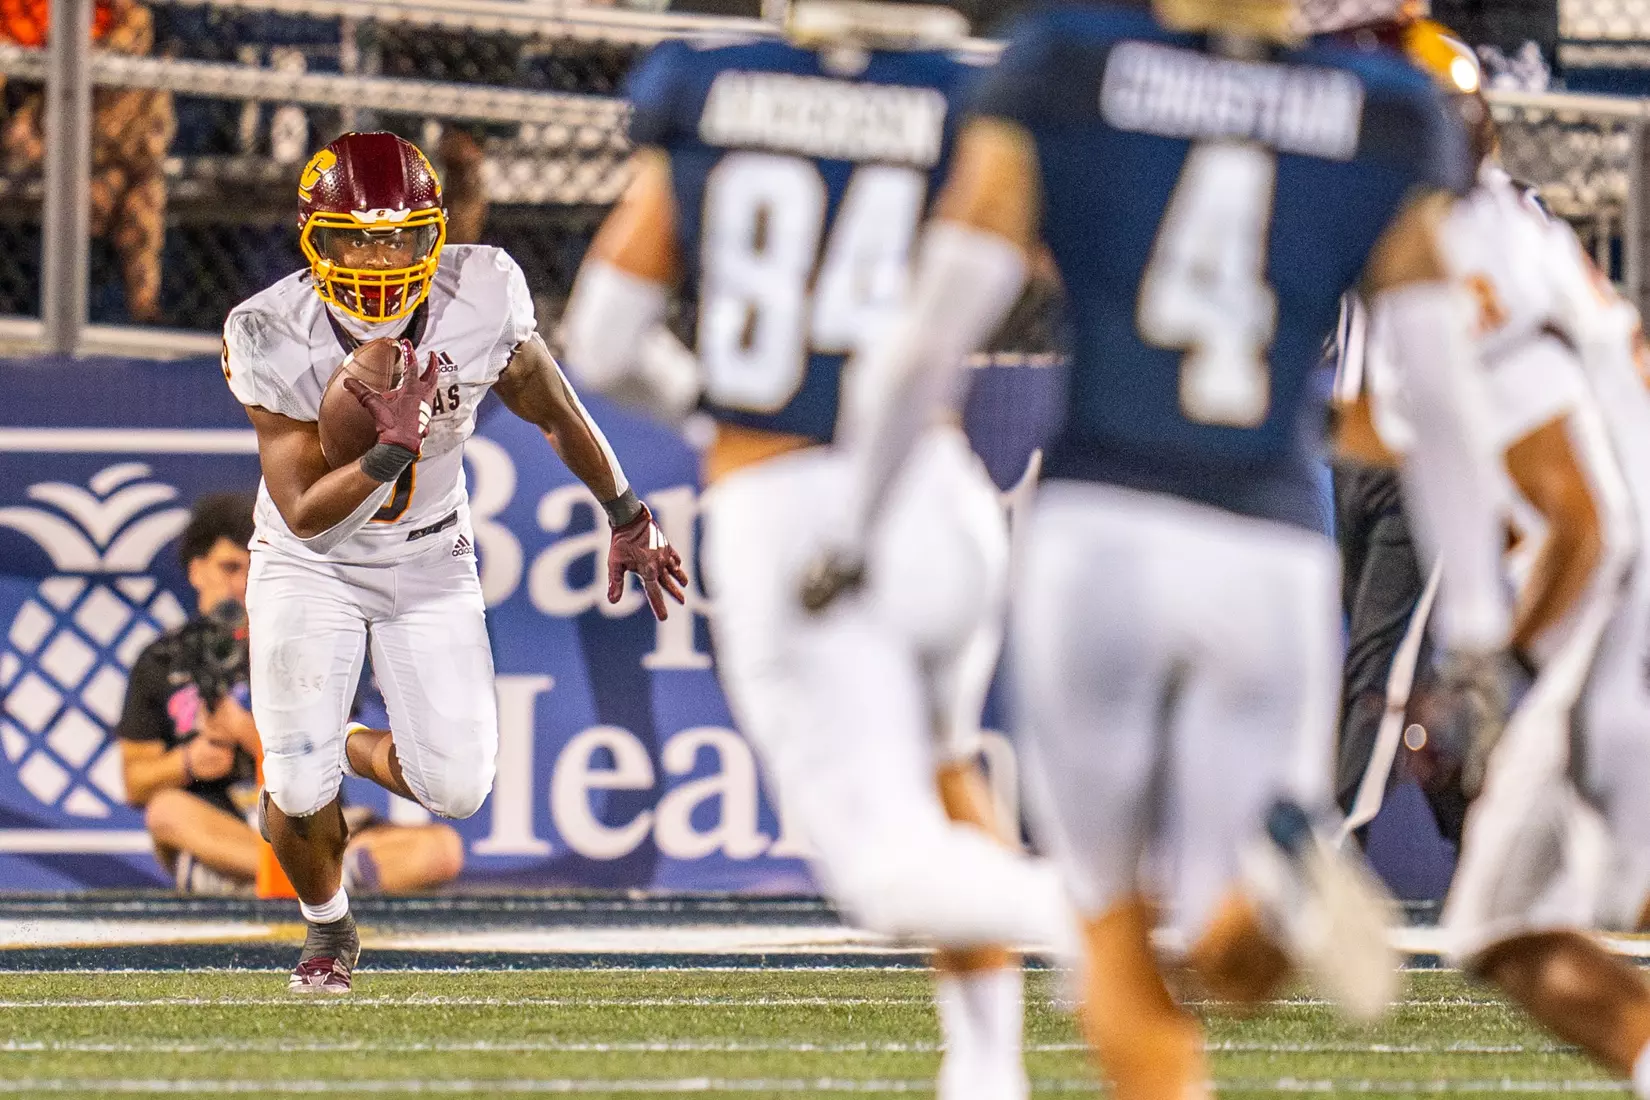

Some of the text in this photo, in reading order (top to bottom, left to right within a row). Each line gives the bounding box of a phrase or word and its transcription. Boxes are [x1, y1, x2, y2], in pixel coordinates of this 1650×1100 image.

[431, 383, 460, 416] AS
[698, 150, 930, 414] 84
[1133, 140, 1278, 429] 4
